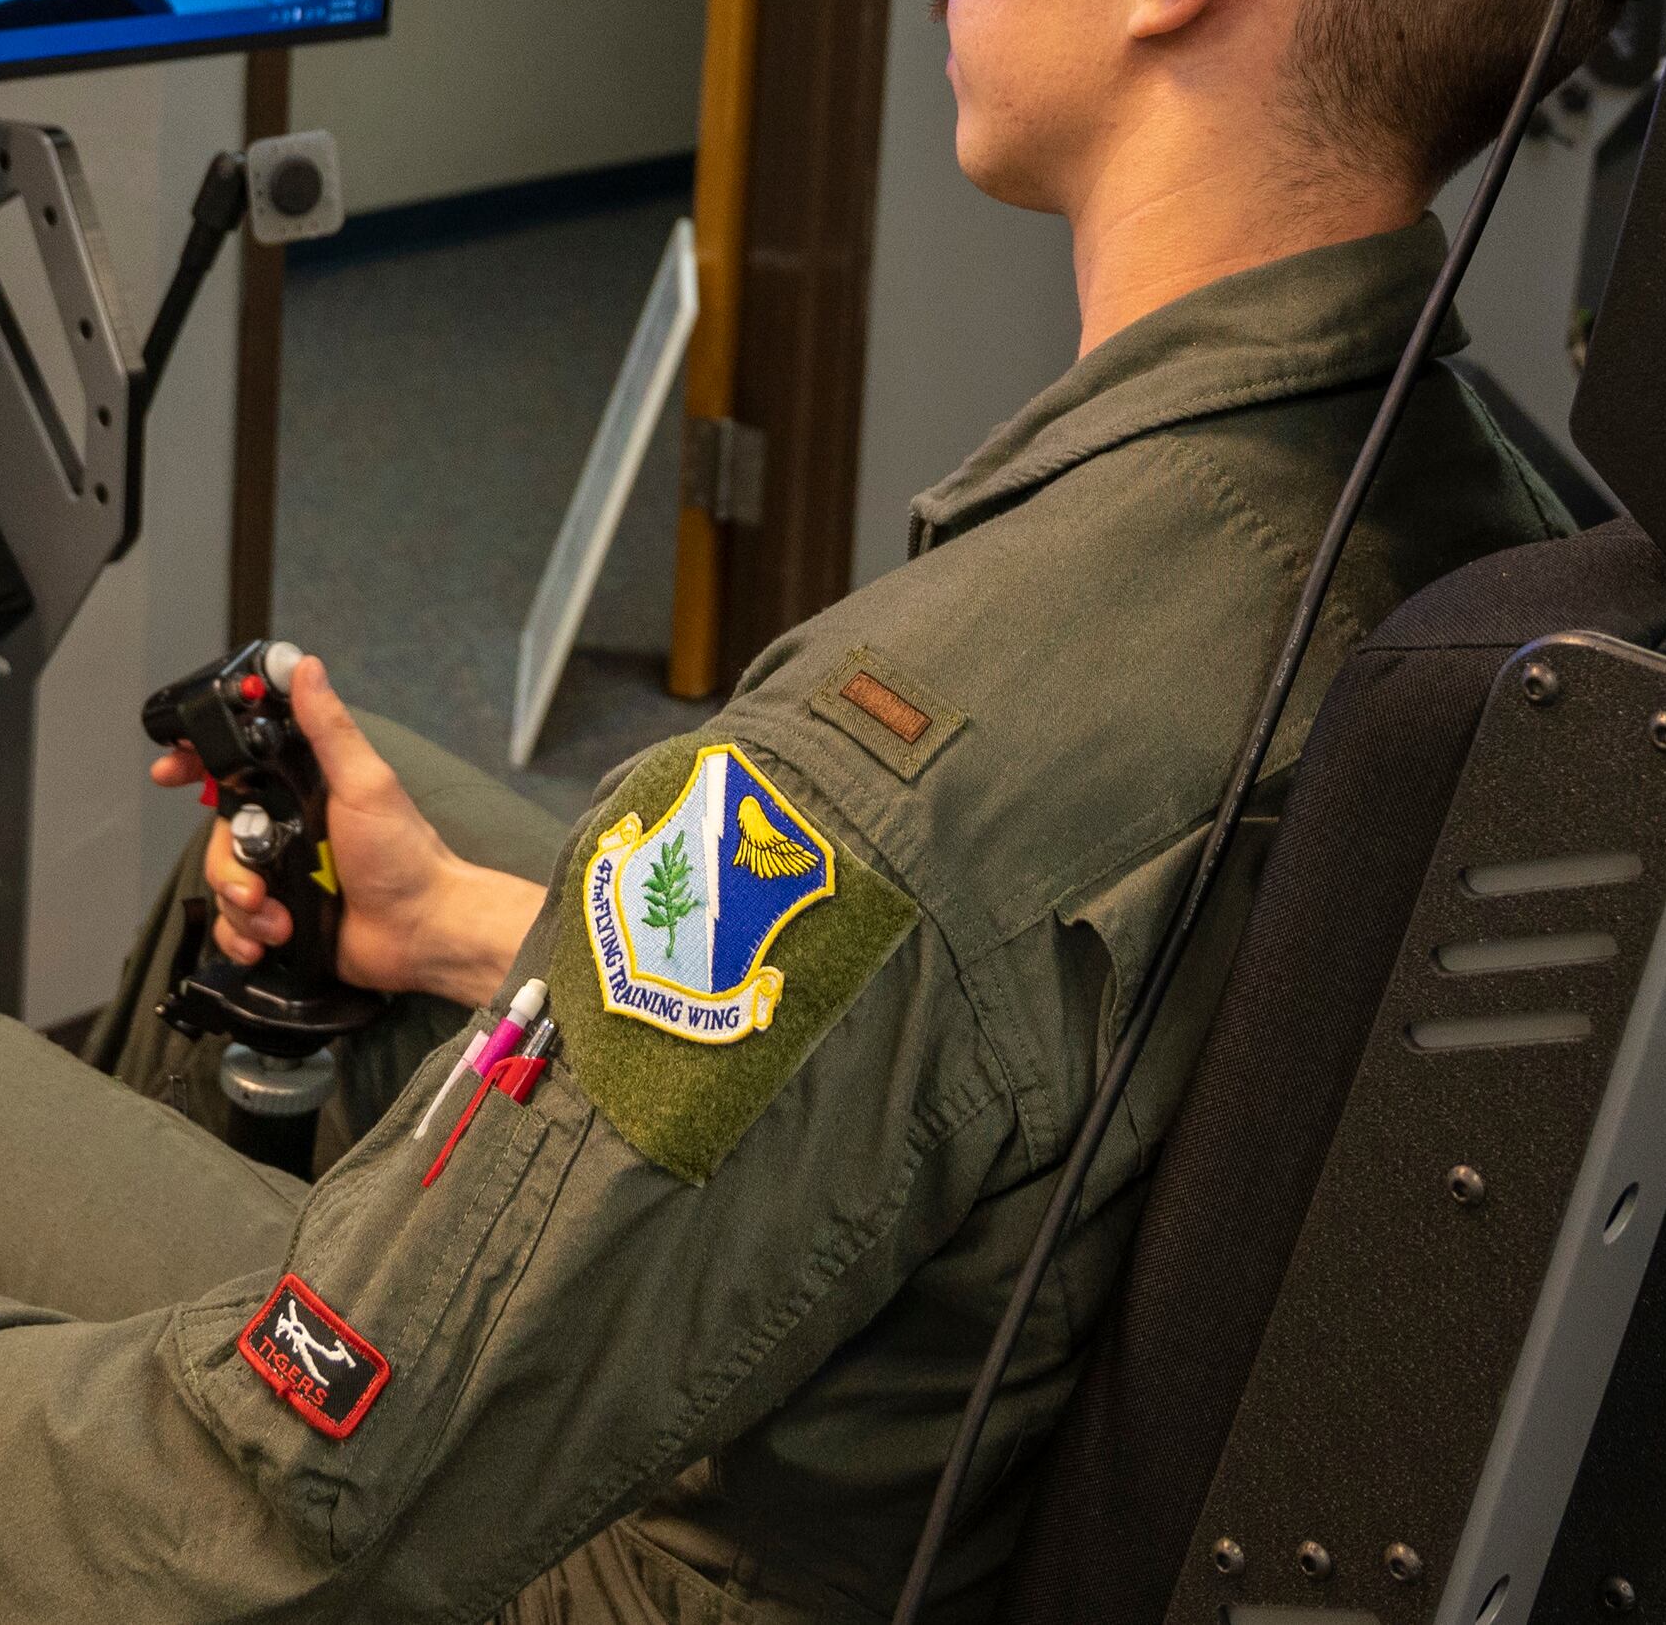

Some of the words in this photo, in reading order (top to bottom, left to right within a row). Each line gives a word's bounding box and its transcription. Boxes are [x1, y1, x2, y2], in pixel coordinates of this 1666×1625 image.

[594, 899, 624, 971] FLYING
[608, 964, 684, 1023] TRAINING
[686, 1004, 741, 1031] WING
[258, 1334, 329, 1408] TIGERS
